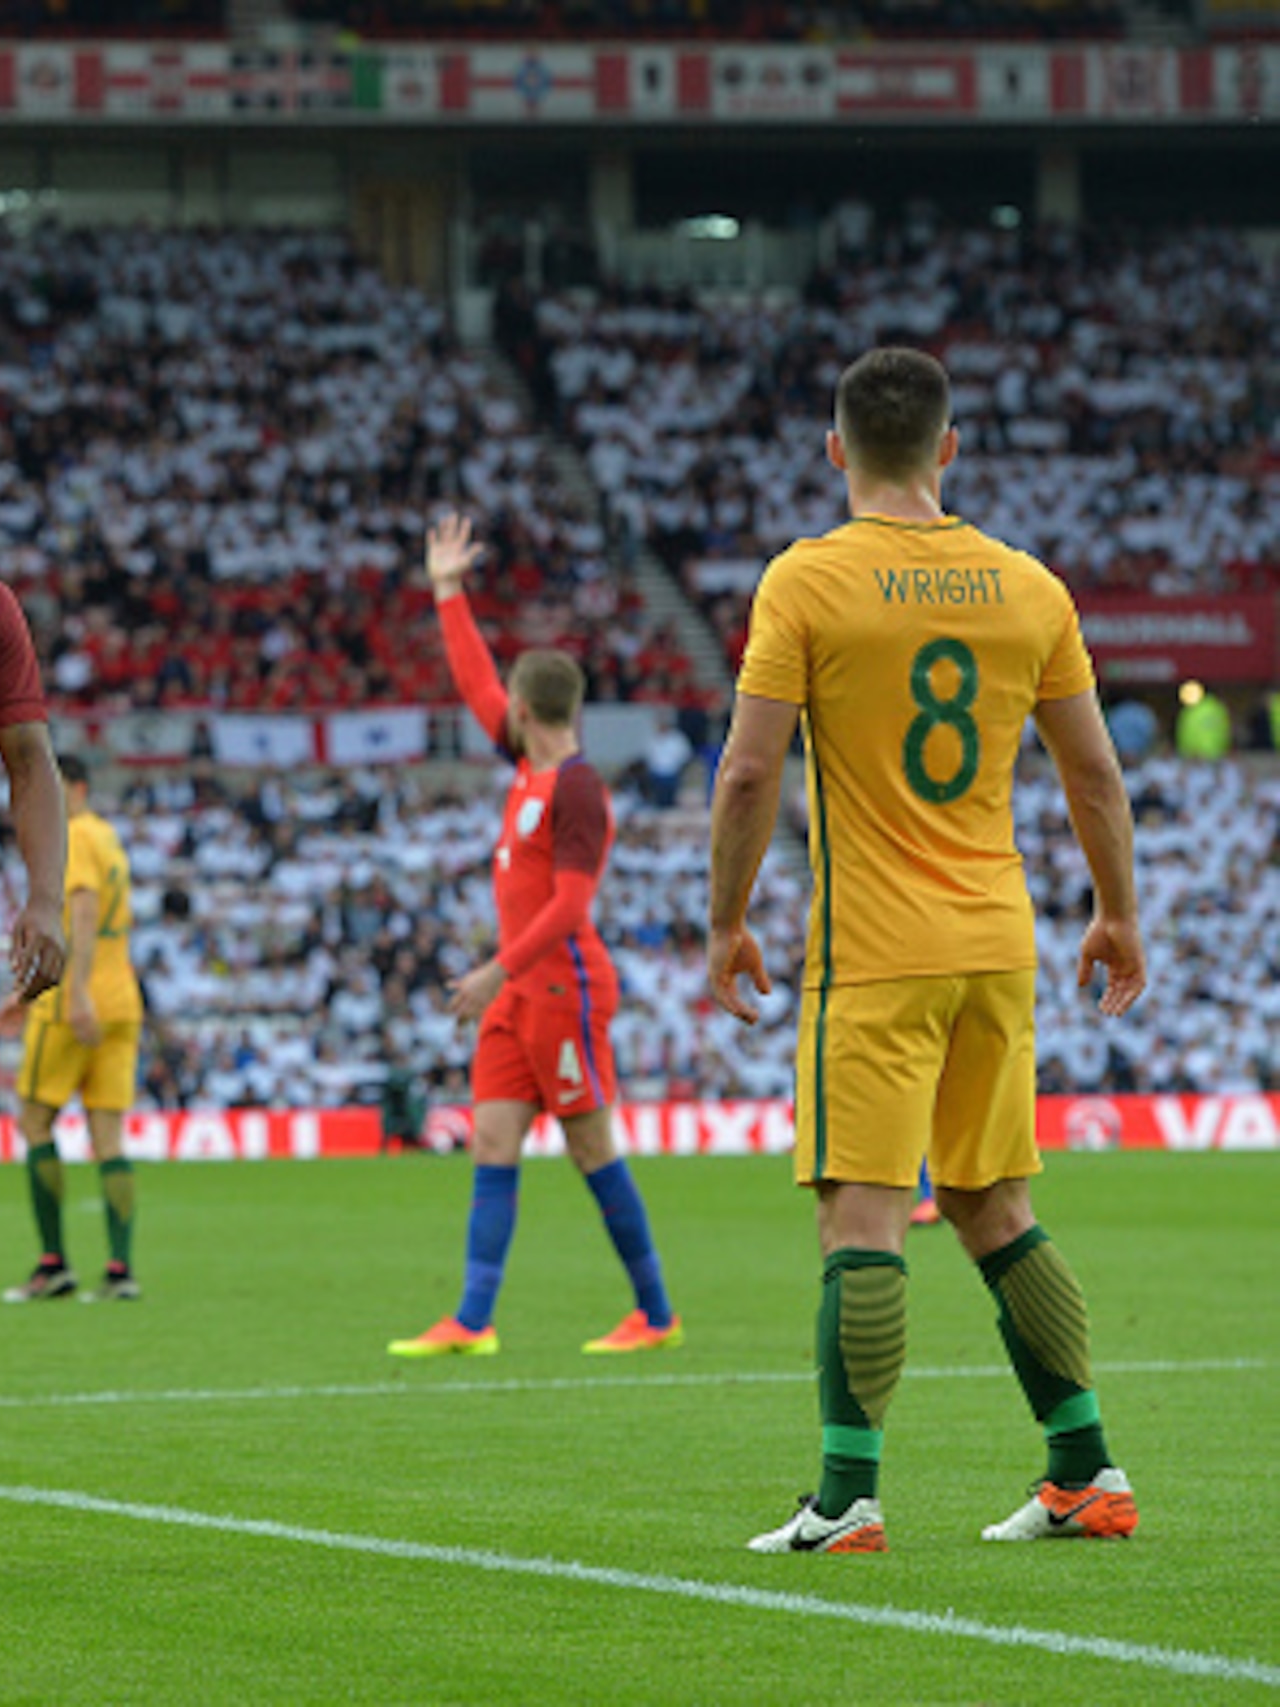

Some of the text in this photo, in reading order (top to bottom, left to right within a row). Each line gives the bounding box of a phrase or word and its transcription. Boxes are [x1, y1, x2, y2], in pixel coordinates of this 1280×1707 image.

[874, 568, 1005, 604] WRIGHT
[902, 636, 980, 806] 8
[556, 1037, 583, 1086] 4
